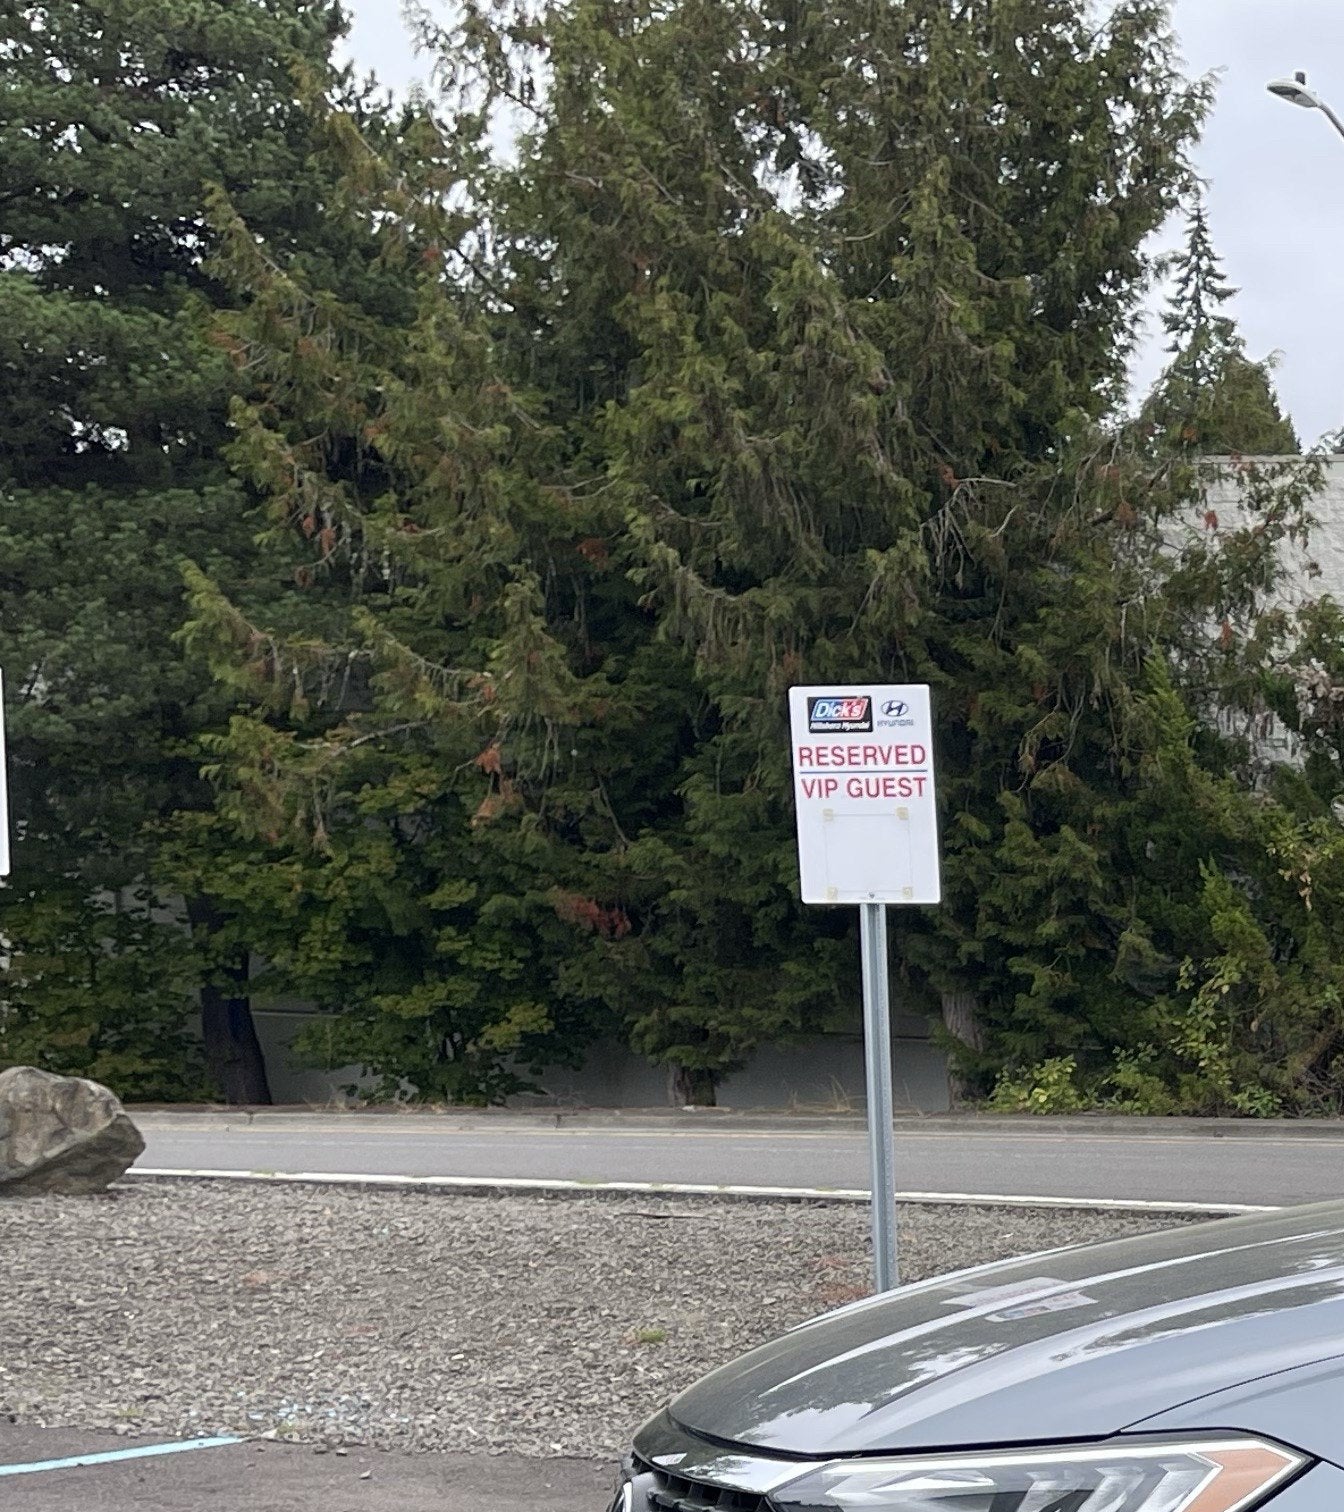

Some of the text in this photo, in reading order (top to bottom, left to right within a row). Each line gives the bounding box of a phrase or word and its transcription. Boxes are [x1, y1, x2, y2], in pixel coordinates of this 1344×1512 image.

[798, 744, 927, 767] RESERVED
[802, 776, 928, 799] VIP GUEST
